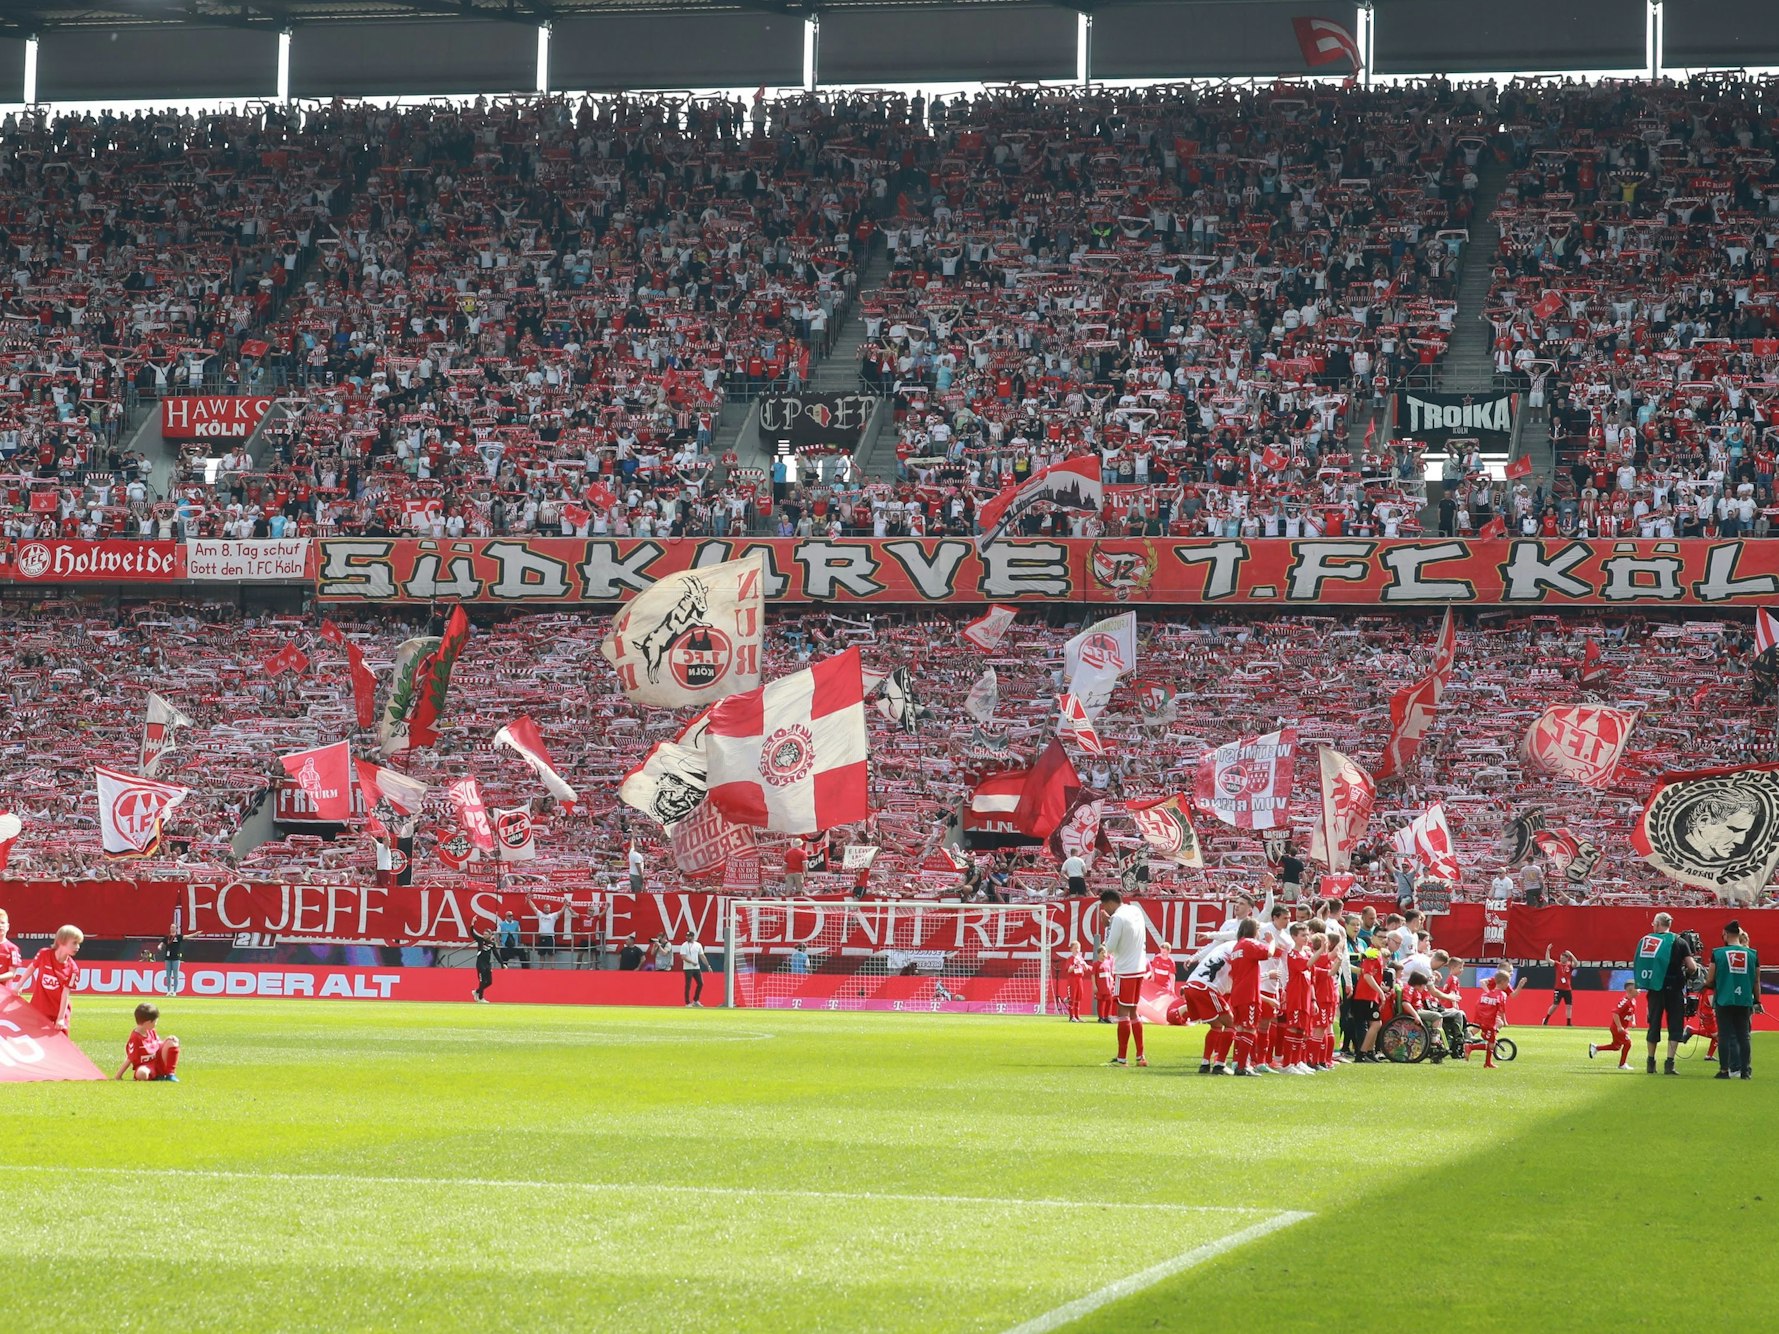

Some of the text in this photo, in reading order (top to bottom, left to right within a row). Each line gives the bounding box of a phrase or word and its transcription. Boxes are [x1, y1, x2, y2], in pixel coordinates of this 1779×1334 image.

[167, 399, 270, 428] HAWKS
[1407, 394, 1511, 433] TROIKA
[195, 420, 246, 437] KÖLN
[195, 542, 301, 560] Am 8. Tag schuf
[53, 545, 175, 578] Holweide
[190, 561, 217, 576] Gott
[221, 562, 243, 576] den
[275, 560, 302, 574] Köln
[1114, 560, 1135, 580] 12
[503, 819, 526, 836] 1.FC
[808, 853, 825, 869] ÖLN
[187, 883, 252, 931] FC
[264, 885, 389, 935] JEFF
[404, 889, 504, 940] JAS
[653, 893, 827, 943] WEED
[841, 896, 939, 947] NIT
[77, 968, 401, 998] JUNG ODER ALT
[1641, 970, 1653, 980] 07
[1734, 985, 1742, 995] 4
